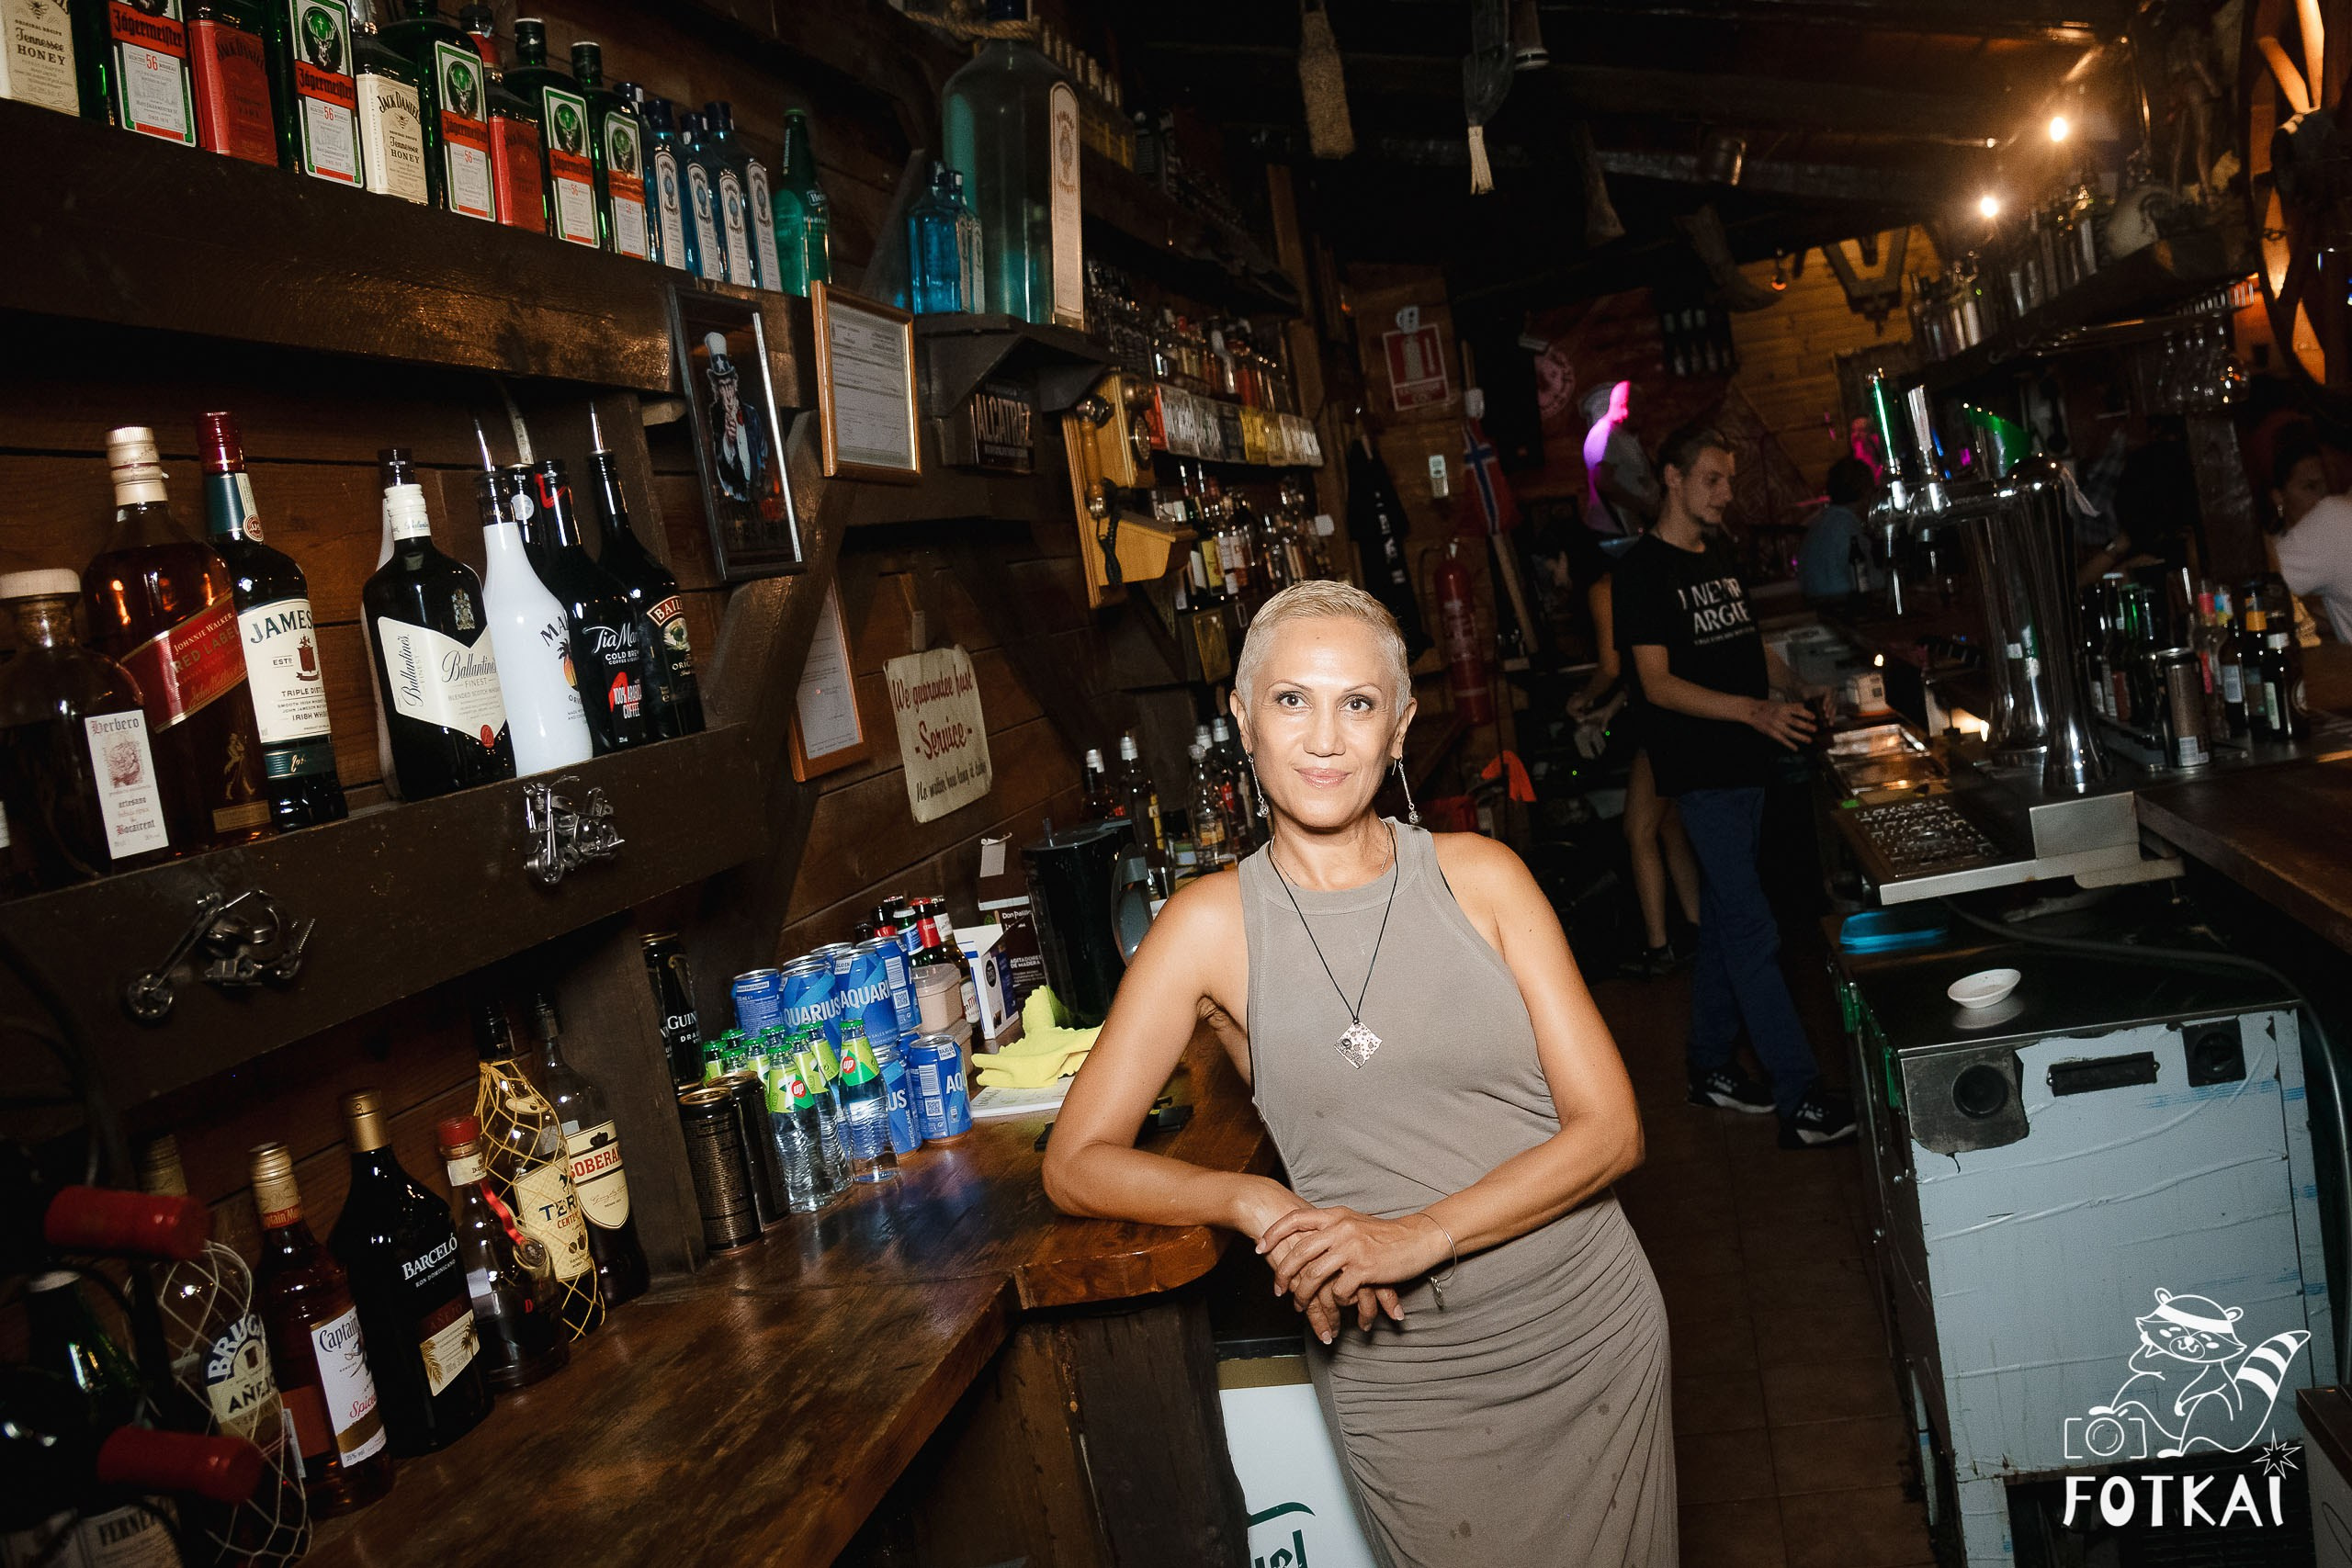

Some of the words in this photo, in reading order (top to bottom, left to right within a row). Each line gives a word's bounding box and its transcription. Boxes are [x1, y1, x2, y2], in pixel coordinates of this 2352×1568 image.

[16, 27, 65, 52] Tennessee
[113, 9, 183, 48] Jägermeister
[17, 44, 65, 66] HONEY
[146, 53, 158, 71] 56
[298, 67, 354, 101] Jägermeister
[323, 106, 334, 120] 56
[377, 91, 398, 114] JACK
[390, 136, 419, 154] Tennessee
[390, 149, 420, 164] HONEY
[975, 393, 1033, 446] ALCATRAZ
[1678, 588, 1688, 610] I
[174, 630, 207, 655] JOHNNIE
[205, 613, 233, 634] WALKER
[582, 626, 617, 654] Tia
[172, 650, 201, 675] RED
[605, 651, 627, 660] COLD
[281, 689, 310, 698] TRIPLE
[464, 678, 488, 688] FINEST
[892, 678, 911, 714] We
[912, 671, 955, 714] guarantee
[447, 693, 470, 702] BLENDED
[292, 712, 313, 721] IRISH
[623, 703, 640, 719] COFFEE
[919, 715, 967, 761] Service
[401, 1232, 458, 1280] BARCELÓ
[415, 1277, 427, 1288] RON
[427, 1258, 456, 1281] DOMINICANO
